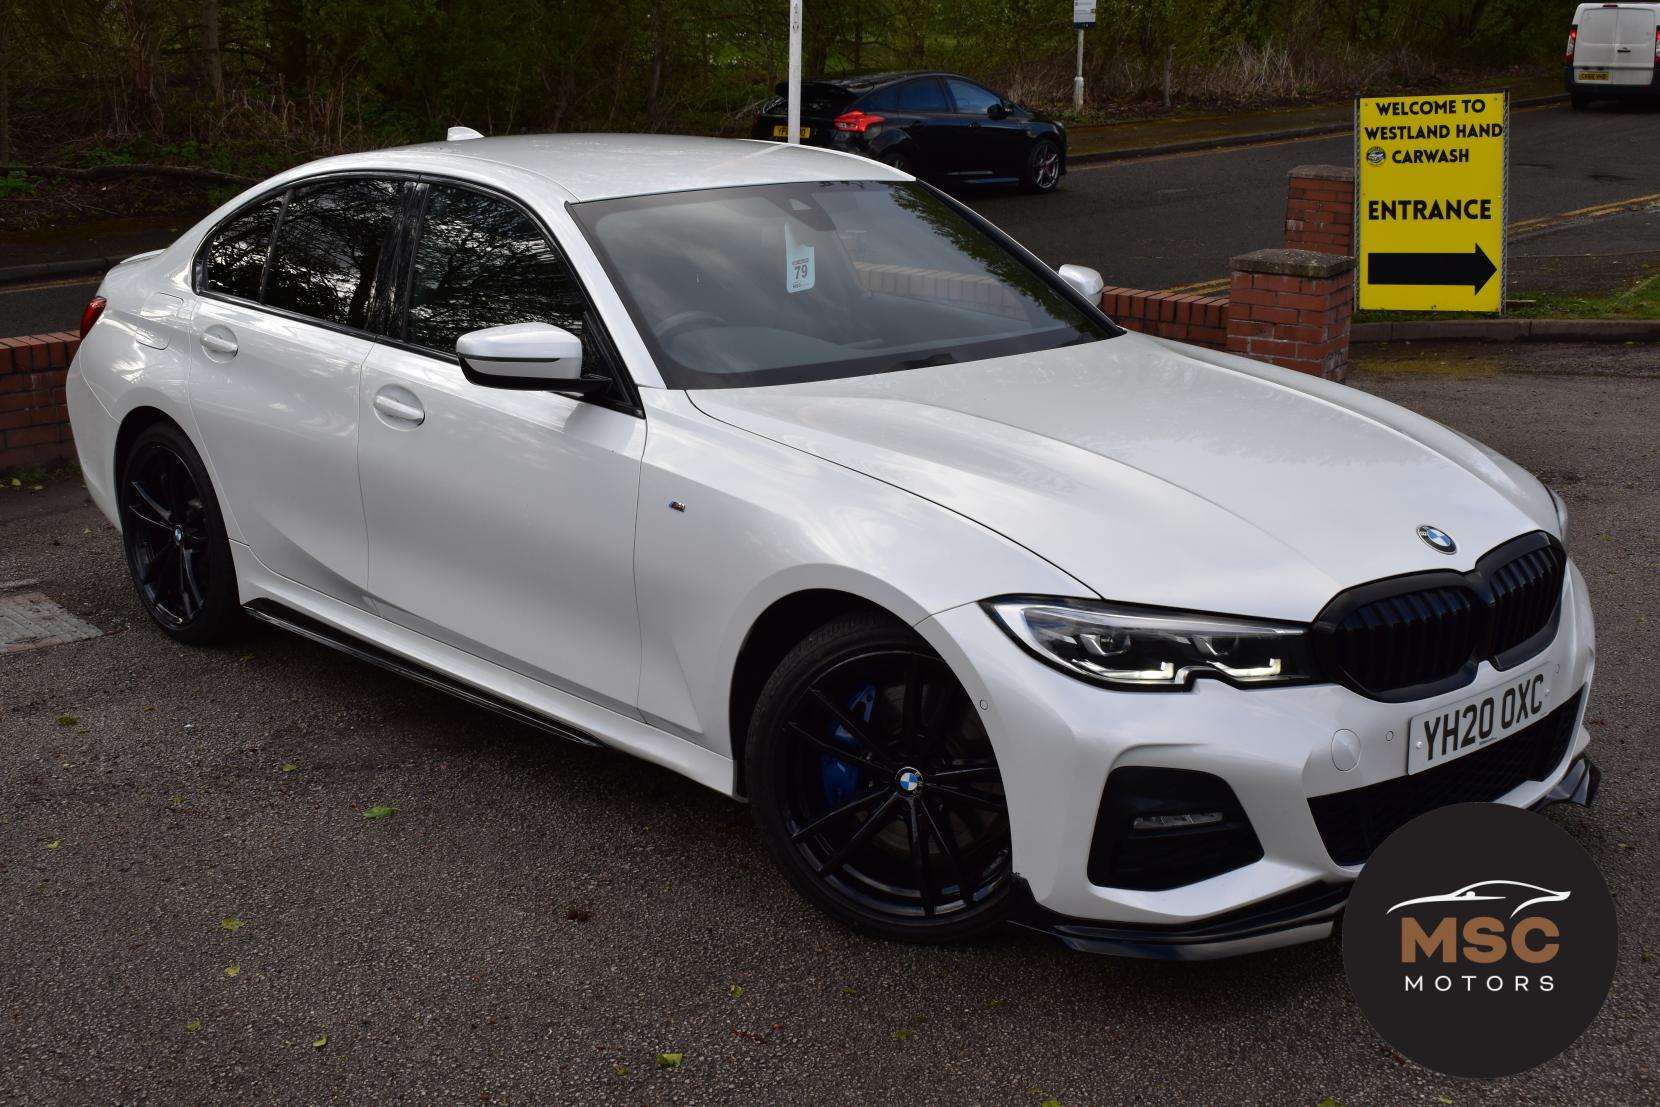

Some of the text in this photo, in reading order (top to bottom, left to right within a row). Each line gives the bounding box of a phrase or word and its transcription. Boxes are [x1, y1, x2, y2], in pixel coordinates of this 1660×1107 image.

[1375, 99, 1486, 116] WELCOME TO
[1364, 123, 1503, 140] WESTLAND HAND
[1392, 148, 1469, 164] CARWASH
[1368, 198, 1492, 221] ENTRANCE
[794, 264, 808, 280] 79
[1423, 673, 1544, 761] YH20 OXC
